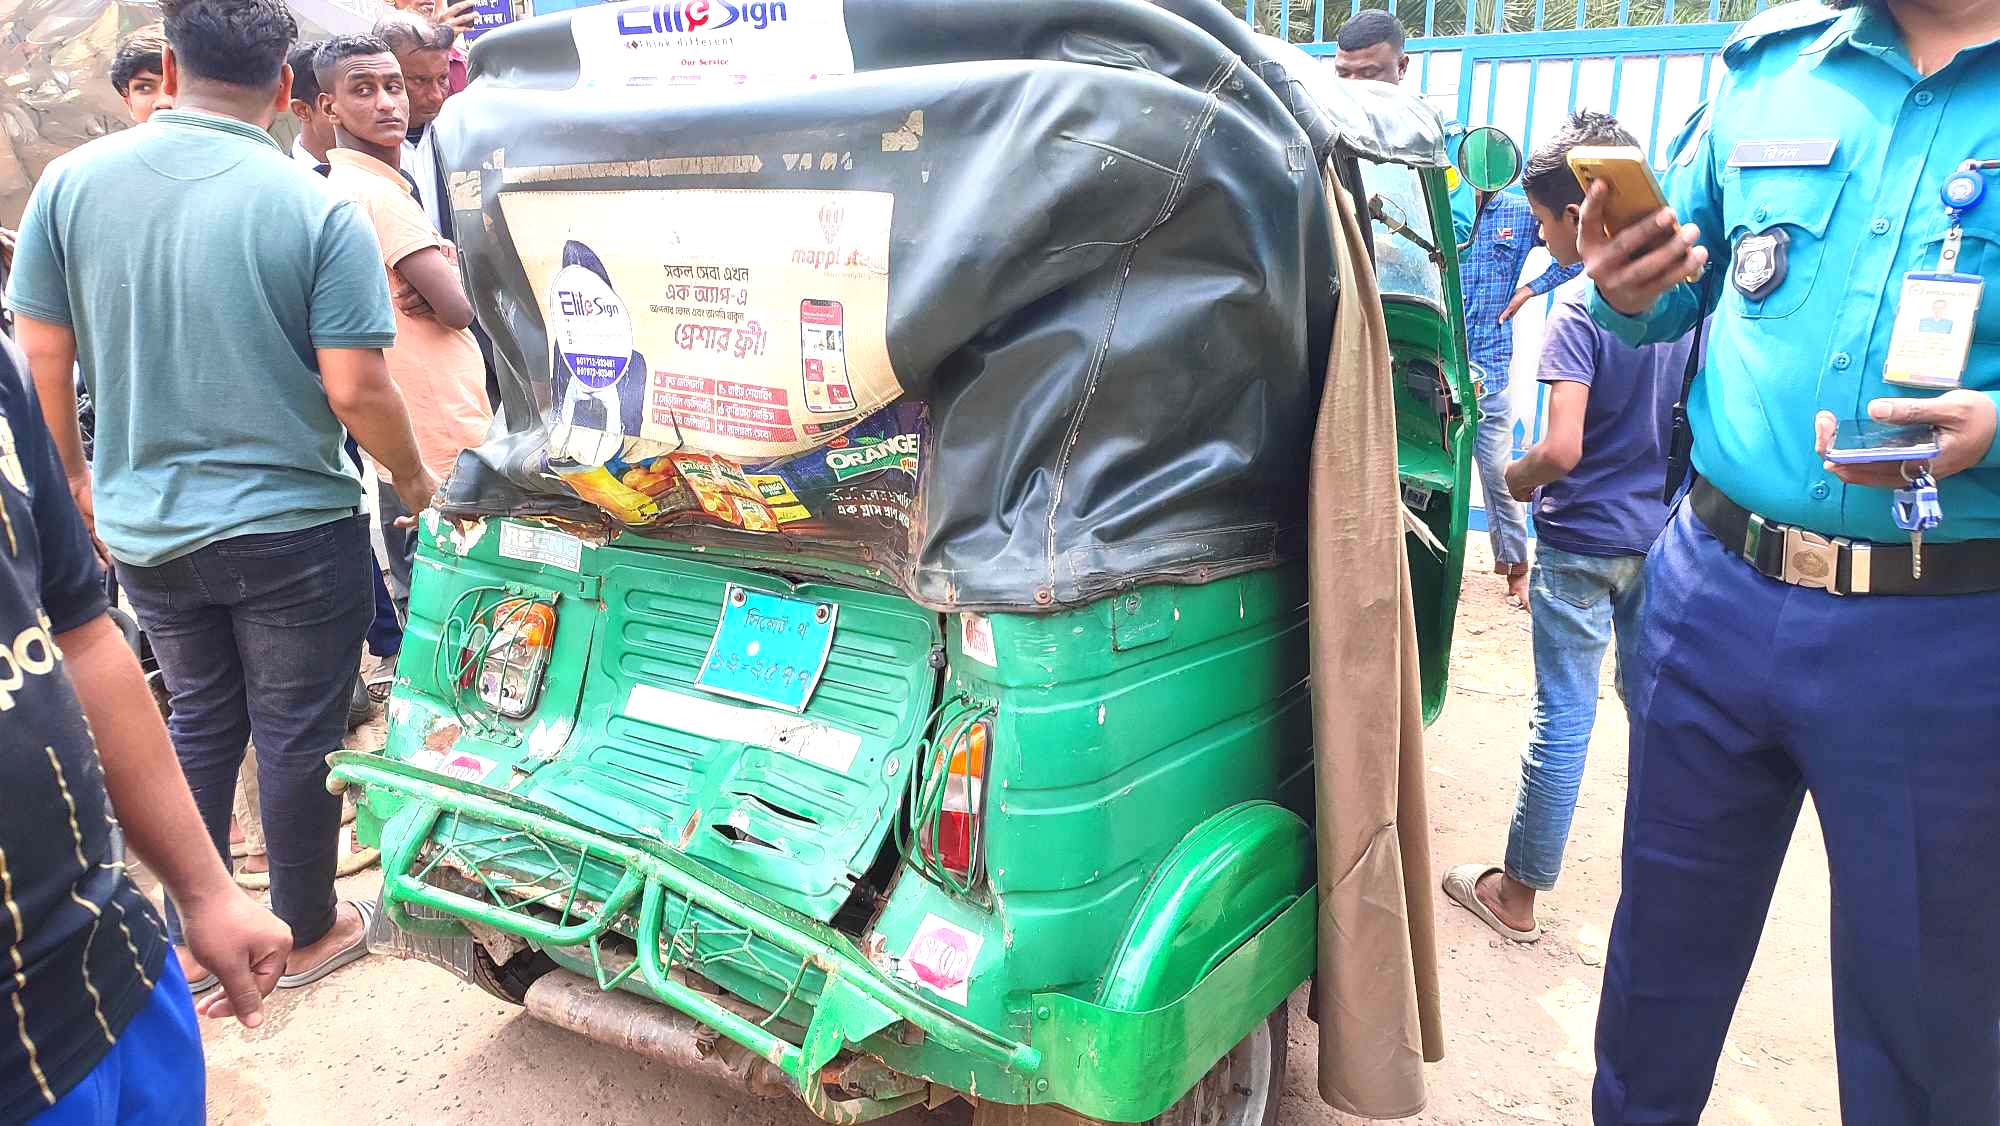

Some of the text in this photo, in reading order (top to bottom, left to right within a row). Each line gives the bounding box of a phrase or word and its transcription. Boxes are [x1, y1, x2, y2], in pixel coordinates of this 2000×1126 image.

[681, 58, 729, 66] Our Service
[664, 264, 750, 283] সকল সেবা এখন
[665, 284, 690, 301] এক
[826, 434, 917, 469] ORANGE
